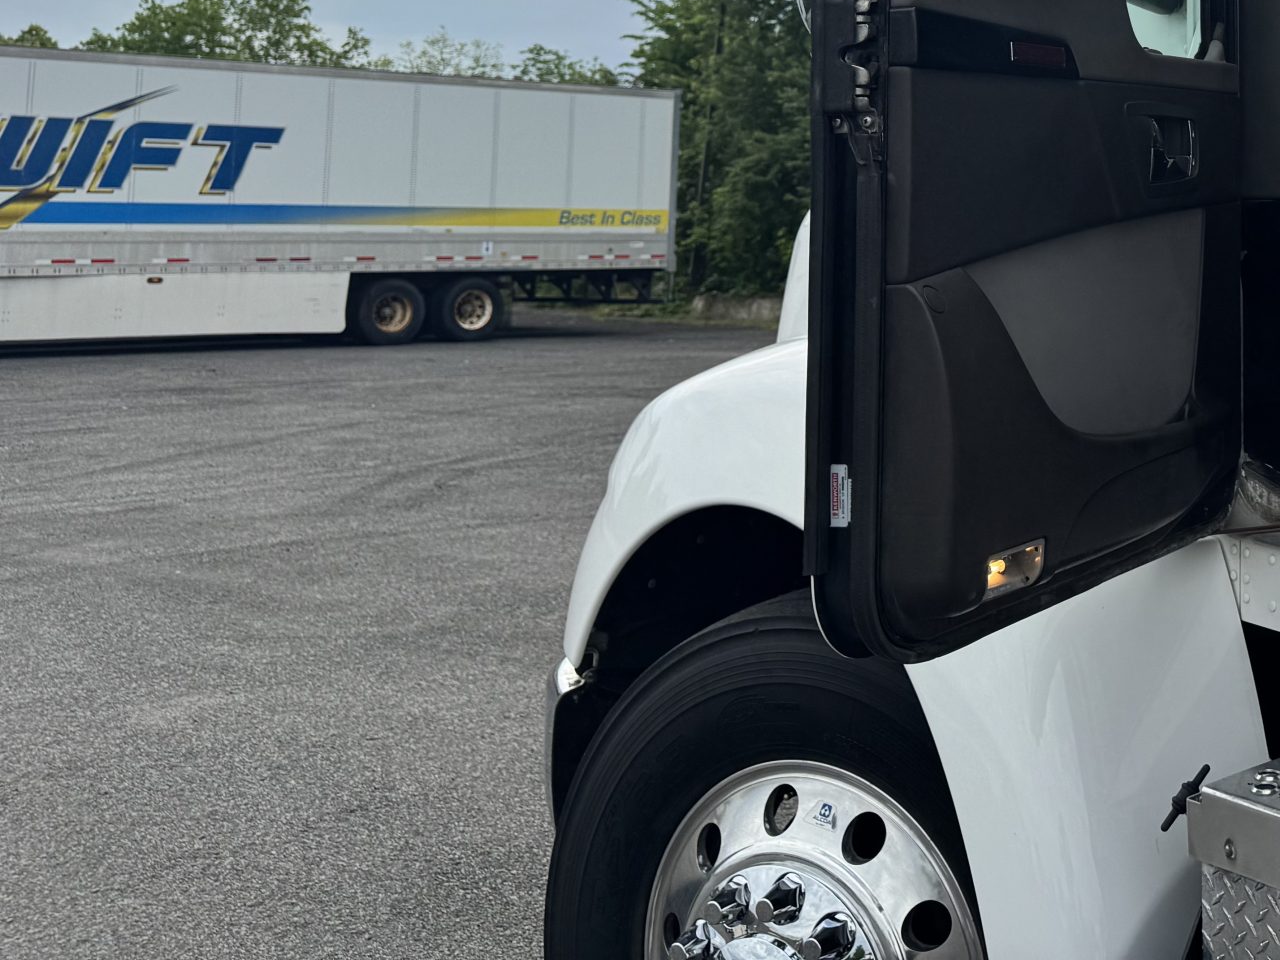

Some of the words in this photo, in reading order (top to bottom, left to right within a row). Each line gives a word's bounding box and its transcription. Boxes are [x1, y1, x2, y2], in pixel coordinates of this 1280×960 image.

[559, 210, 595, 225] Best
[601, 211, 615, 225] In
[621, 211, 661, 225] Class
